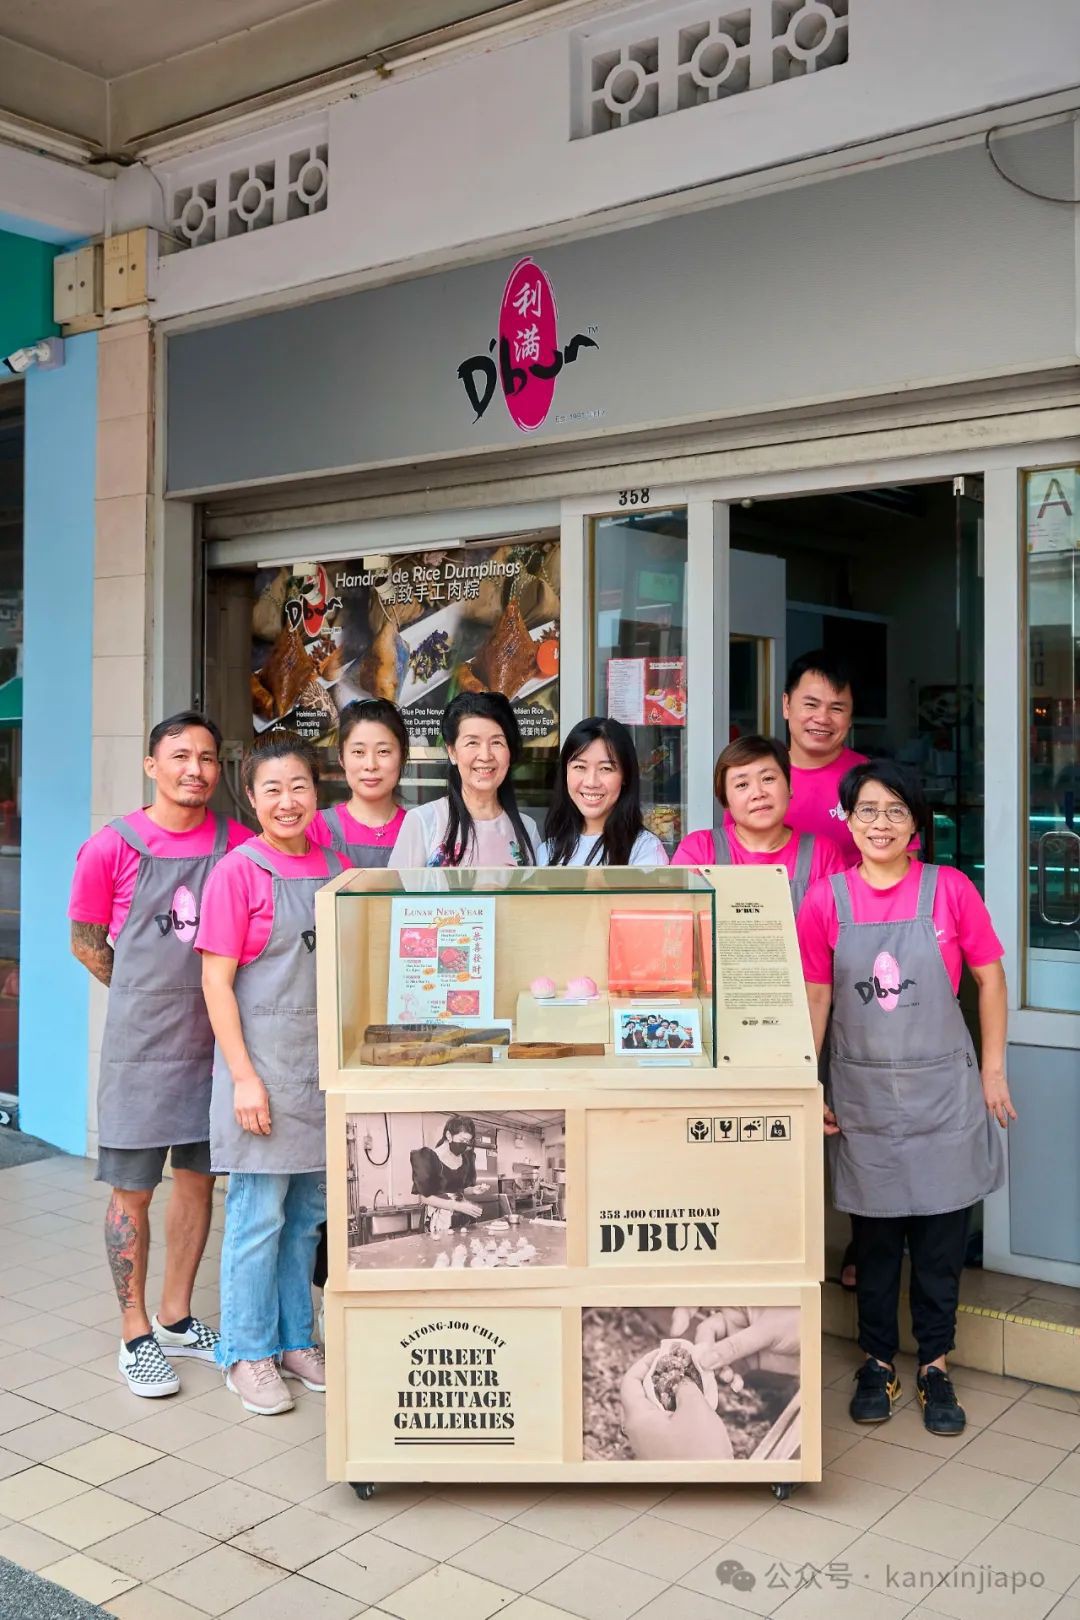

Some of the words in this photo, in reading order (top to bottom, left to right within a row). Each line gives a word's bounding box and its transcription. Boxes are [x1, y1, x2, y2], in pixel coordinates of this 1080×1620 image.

[618, 488, 650, 506] 358
[1037, 478, 1073, 518] A
[335, 568, 409, 588] Handde
[413, 566, 441, 582] Rice
[445, 561, 521, 580] Dumplings
[402, 708, 414, 716] Blue
[531, 706, 544, 714] Rice
[414, 718, 440, 726] Dumpling
[436, 907, 456, 916] NEW
[460, 907, 483, 916] YEAR
[155, 909, 200, 937] D'bu
[599, 1210, 620, 1219] 358
[624, 1209, 646, 1219] JOO
[649, 1208, 685, 1218] CHIAT
[688, 1207, 720, 1217] ROAD
[599, 1222, 720, 1253] D'BUN
[400, 1320, 470, 1349] KATONG-JOO
[472, 1324, 507, 1348] CHIAT
[411, 1348, 496, 1366] STREET
[408, 1369, 500, 1387] CORNER
[397, 1391, 511, 1408] HERITAGE
[393, 1412, 515, 1430] GALLERIES
